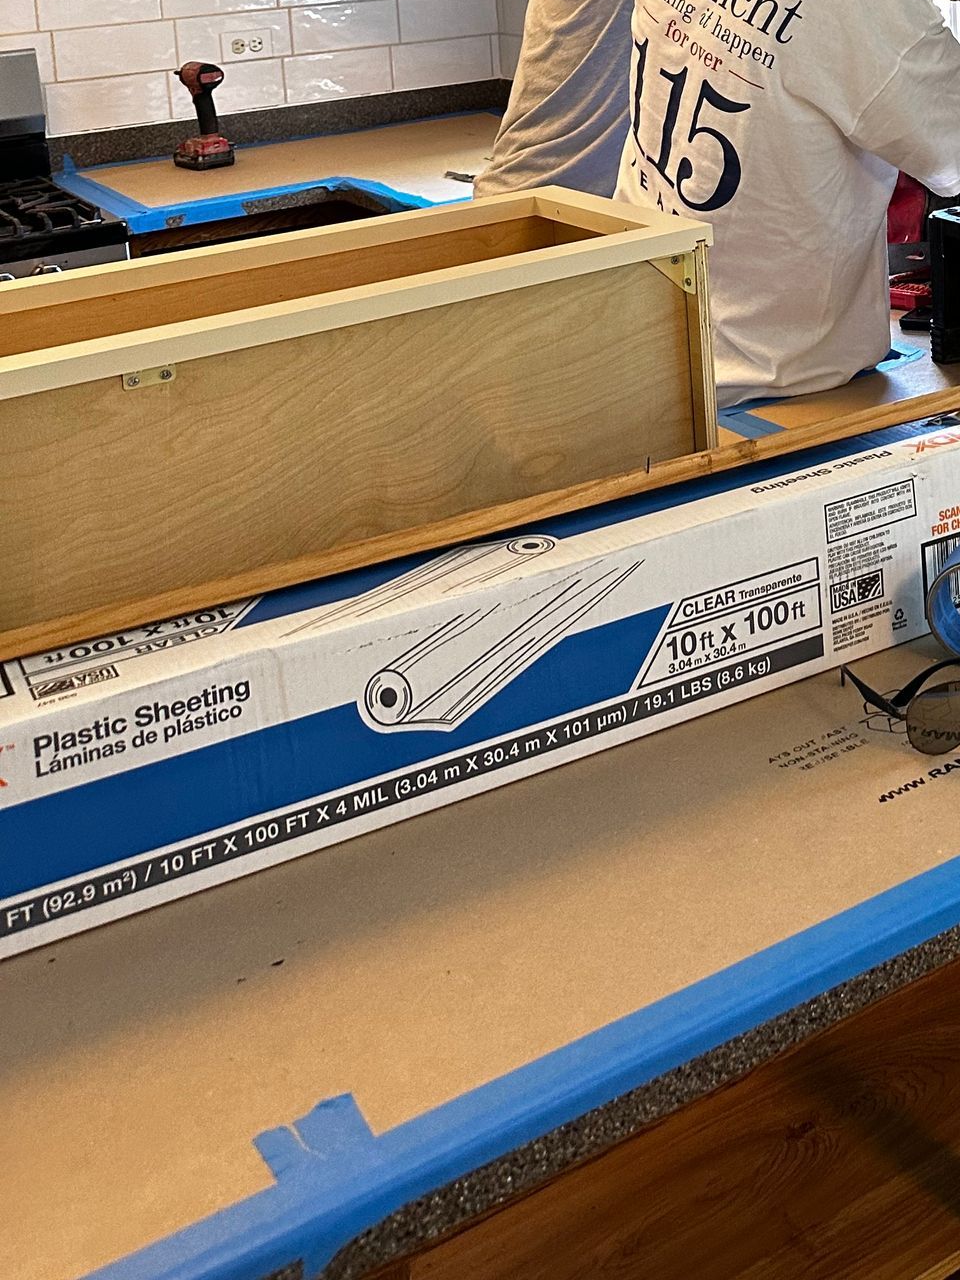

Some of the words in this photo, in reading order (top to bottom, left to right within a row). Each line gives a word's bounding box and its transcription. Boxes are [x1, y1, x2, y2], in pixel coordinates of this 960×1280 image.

[664, 20, 690, 48] for
[690, 41, 723, 72] over
[699, 8, 714, 28] it
[711, 16, 776, 70] happen
[633, 37, 751, 211] 115
[836, 450, 893, 470] Plastic
[750, 468, 833, 495] Sheeting
[931, 522, 950, 537] FOR
[682, 590, 736, 618] CLEAR
[739, 573, 802, 601] Transparente
[833, 582, 850, 595] MADE
[834, 589, 857, 609] USA
[135, 626, 218, 654] CLEAR
[668, 658, 693, 674] 3.04
[713, 642, 737, 659] 30.4
[33, 717, 128, 758] Plastic
[134, 679, 251, 729] Sheeting
[35, 739, 127, 778] Láminas
[132, 730, 158, 749] de
[163, 705, 243, 743] plástico
[793, 739, 817, 753] OUT
[6, 903, 35, 928] FT
[43, 884, 96, 919] (92.9
[144, 864, 152, 882] /
[160, 855, 184, 875] 10
[191, 844, 217, 866] FT
[223, 837, 239, 855] X
[244, 822, 279, 847] 100
[285, 811, 311, 833] FT
[316, 806, 331, 823] X
[336, 799, 347, 816] 4
[353, 790, 389, 811] MIL
[394, 771, 438, 799] (3.04
[444, 765, 461, 781] m
[466, 757, 479, 773] X
[483, 742, 520, 767] 30.4
[525, 737, 541, 753] m
[546, 729, 559, 745] X
[563, 718, 591, 739] 101
[632, 700, 639, 717] /
[643, 689, 676, 711] 19.1
[680, 677, 712, 699] LBS
[716, 666, 744, 690] (8.6
[748, 656, 771, 677] kg)
